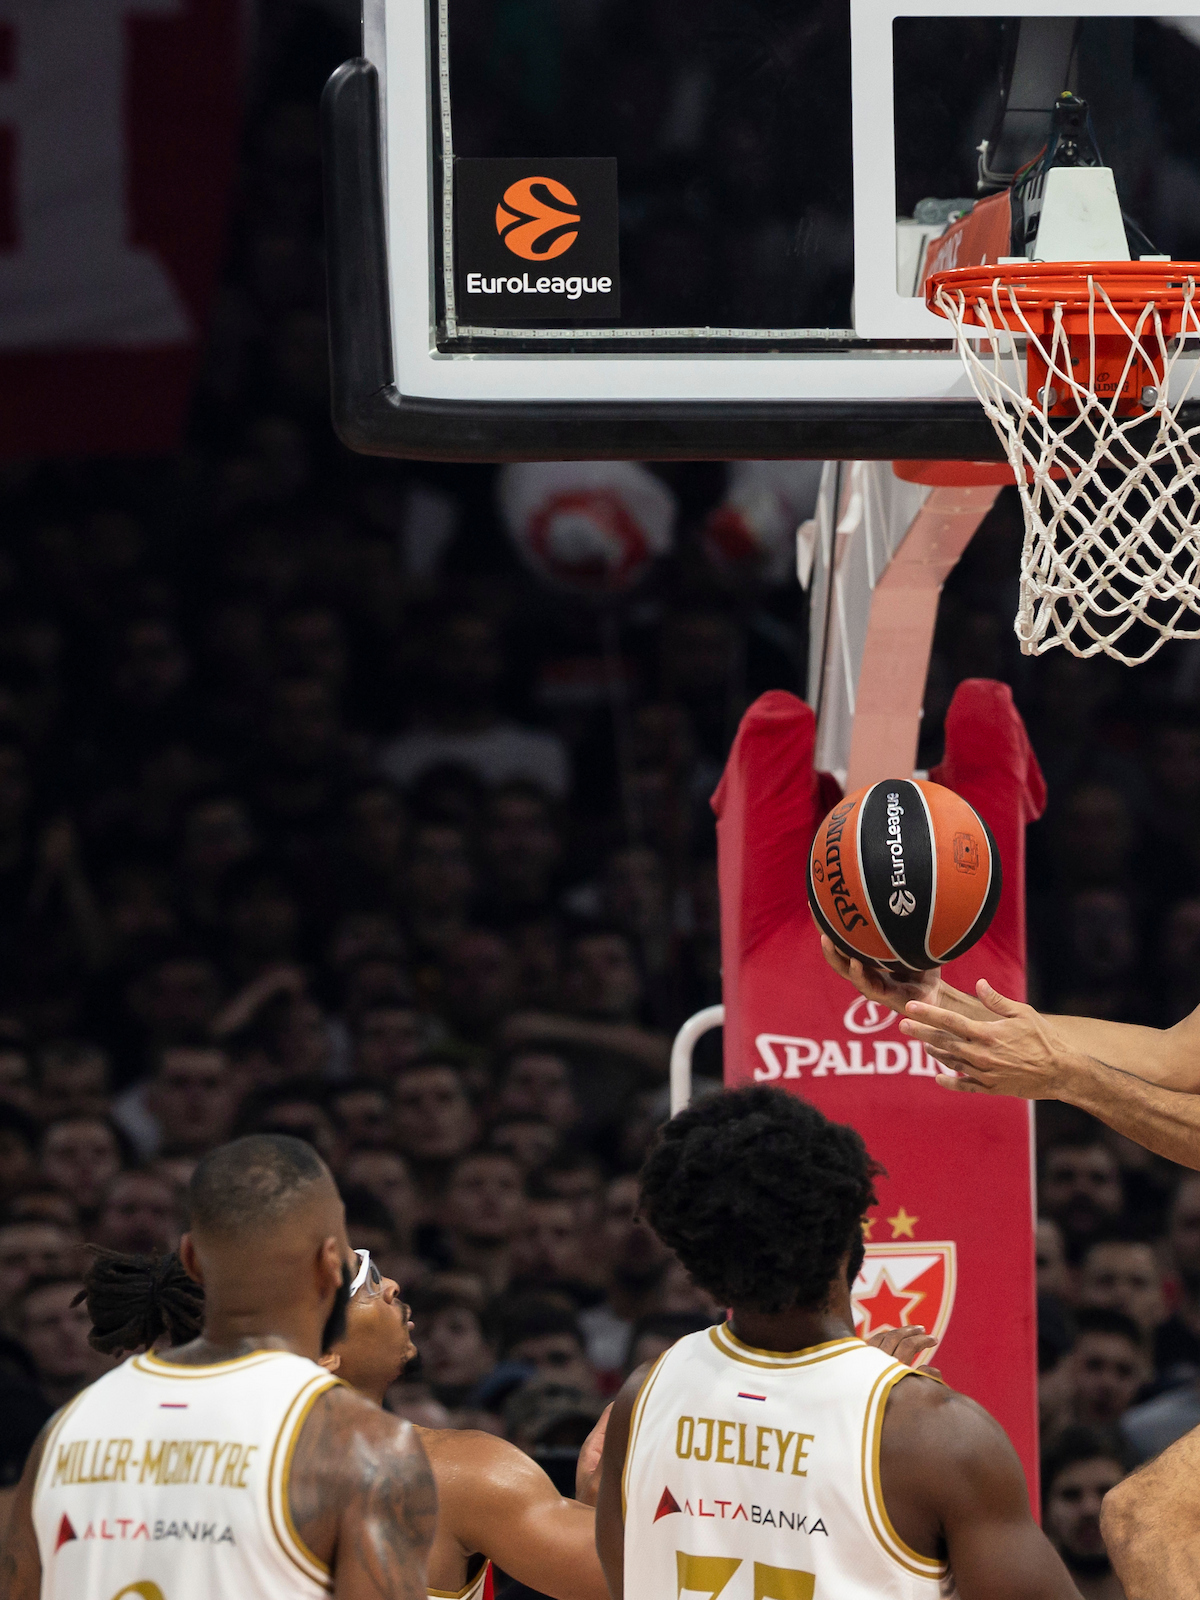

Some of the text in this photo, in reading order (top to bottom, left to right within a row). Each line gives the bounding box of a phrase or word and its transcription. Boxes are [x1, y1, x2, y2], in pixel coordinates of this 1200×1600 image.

[466, 272, 613, 300] EuroLeague
[825, 801, 869, 932] SPALDING
[886, 792, 907, 888] EuroLeague
[753, 1032, 958, 1082] SPALDI
[675, 1415, 815, 1478] OJELEYE
